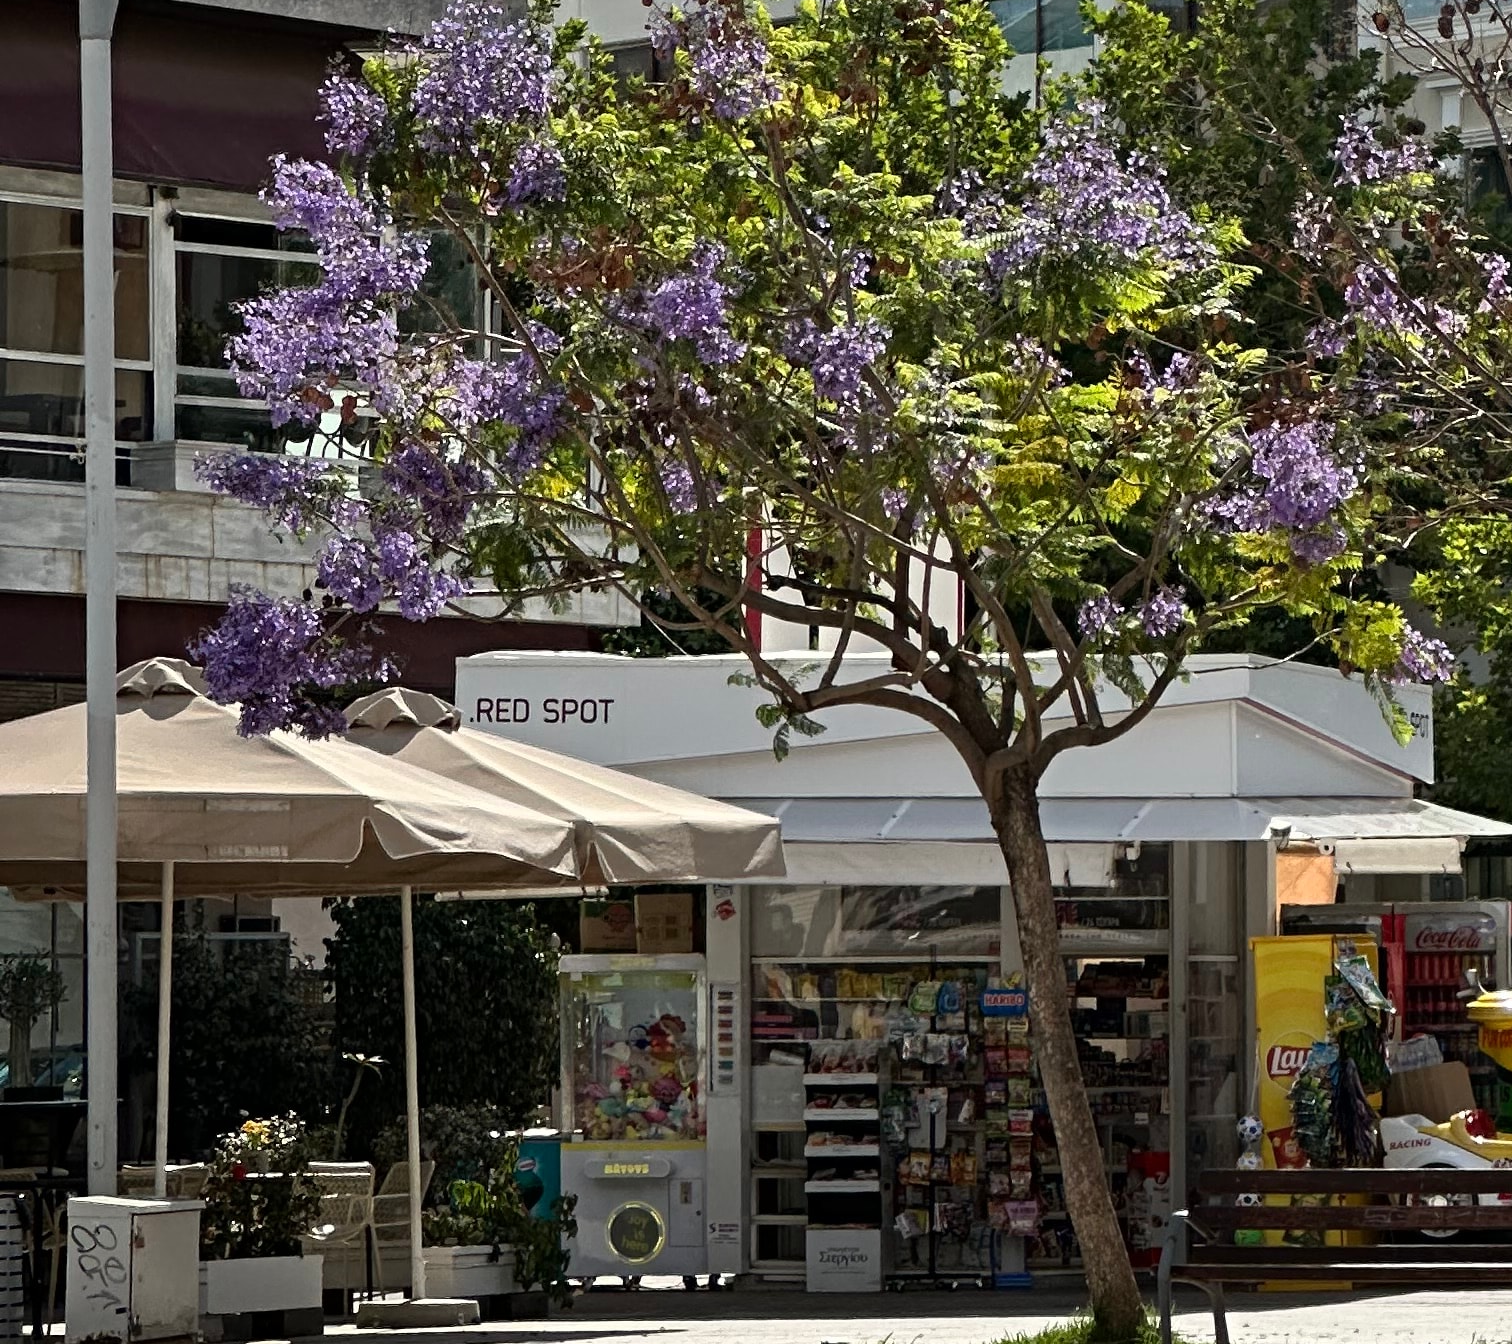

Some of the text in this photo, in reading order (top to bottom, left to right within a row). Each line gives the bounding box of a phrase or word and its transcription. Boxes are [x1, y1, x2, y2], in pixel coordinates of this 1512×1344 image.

[542, 698, 615, 724] SPOT
[984, 993, 1026, 1007] HARIBO
[1389, 1137, 1432, 1151] RACING
